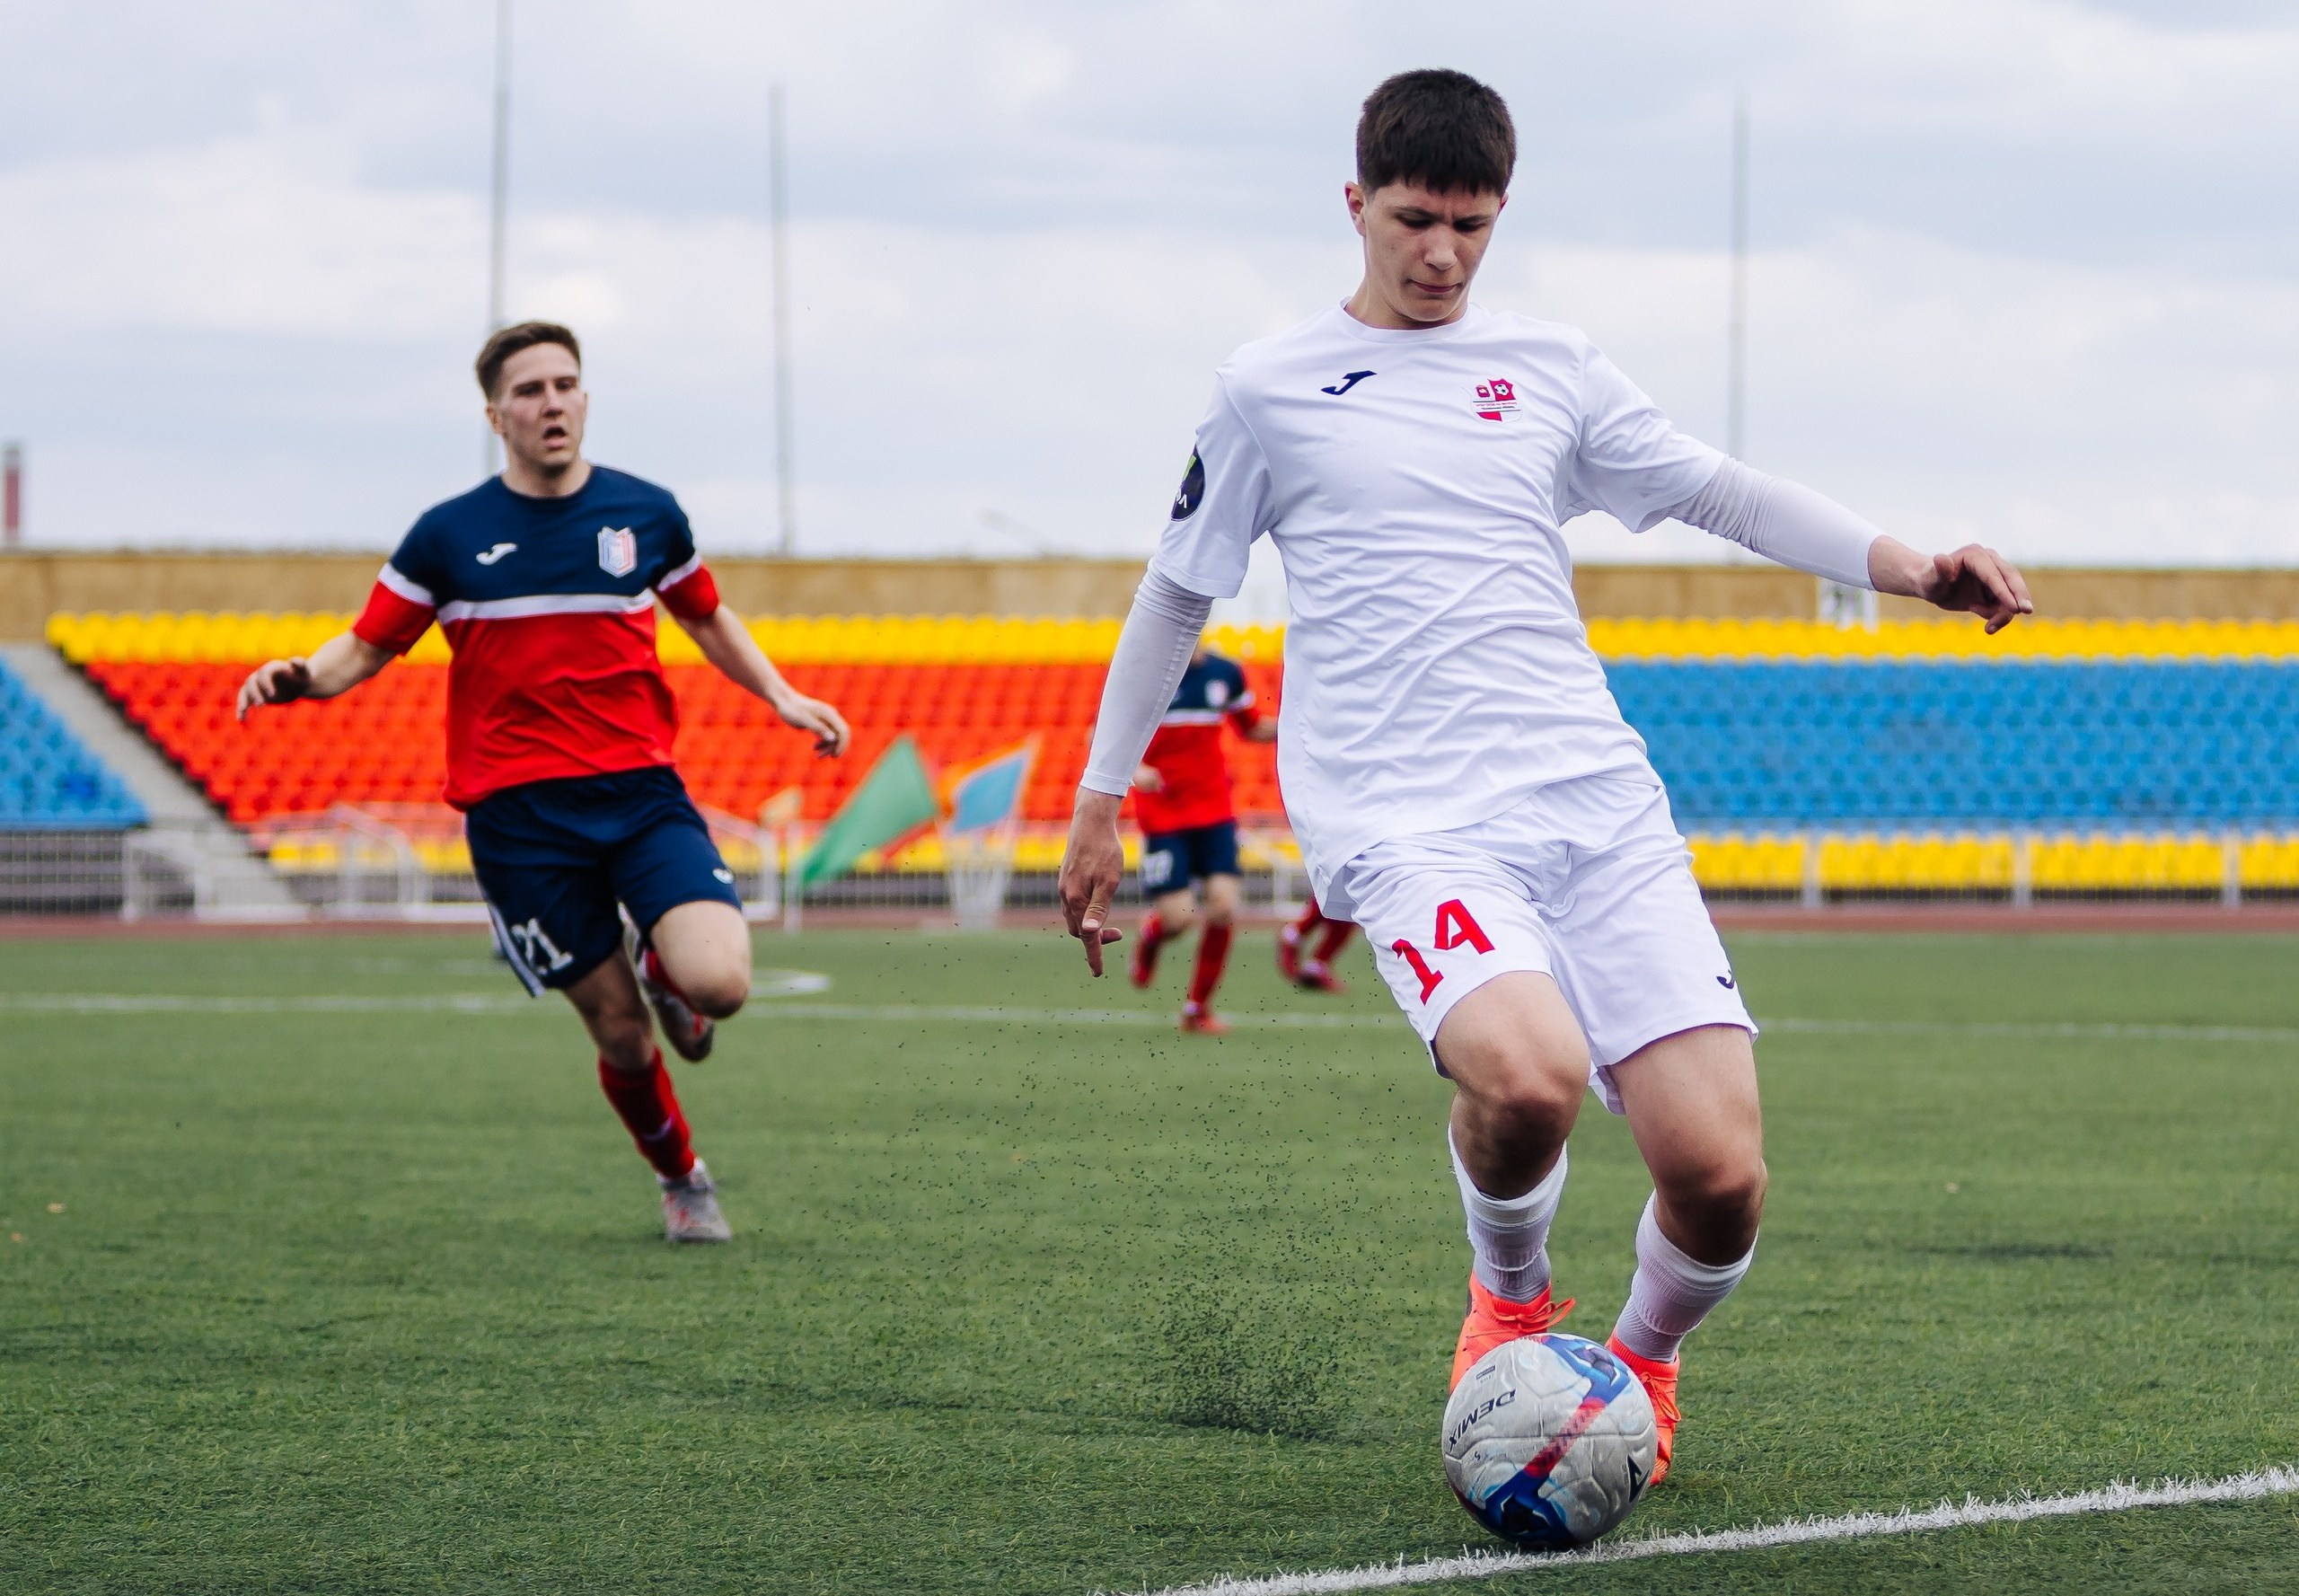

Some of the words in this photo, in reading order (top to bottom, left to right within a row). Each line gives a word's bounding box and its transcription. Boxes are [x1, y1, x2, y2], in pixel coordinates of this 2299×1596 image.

[510, 917, 574, 976] 21
[1391, 899, 1495, 1006] 14
[1448, 1389, 1516, 1451] DEMIX
